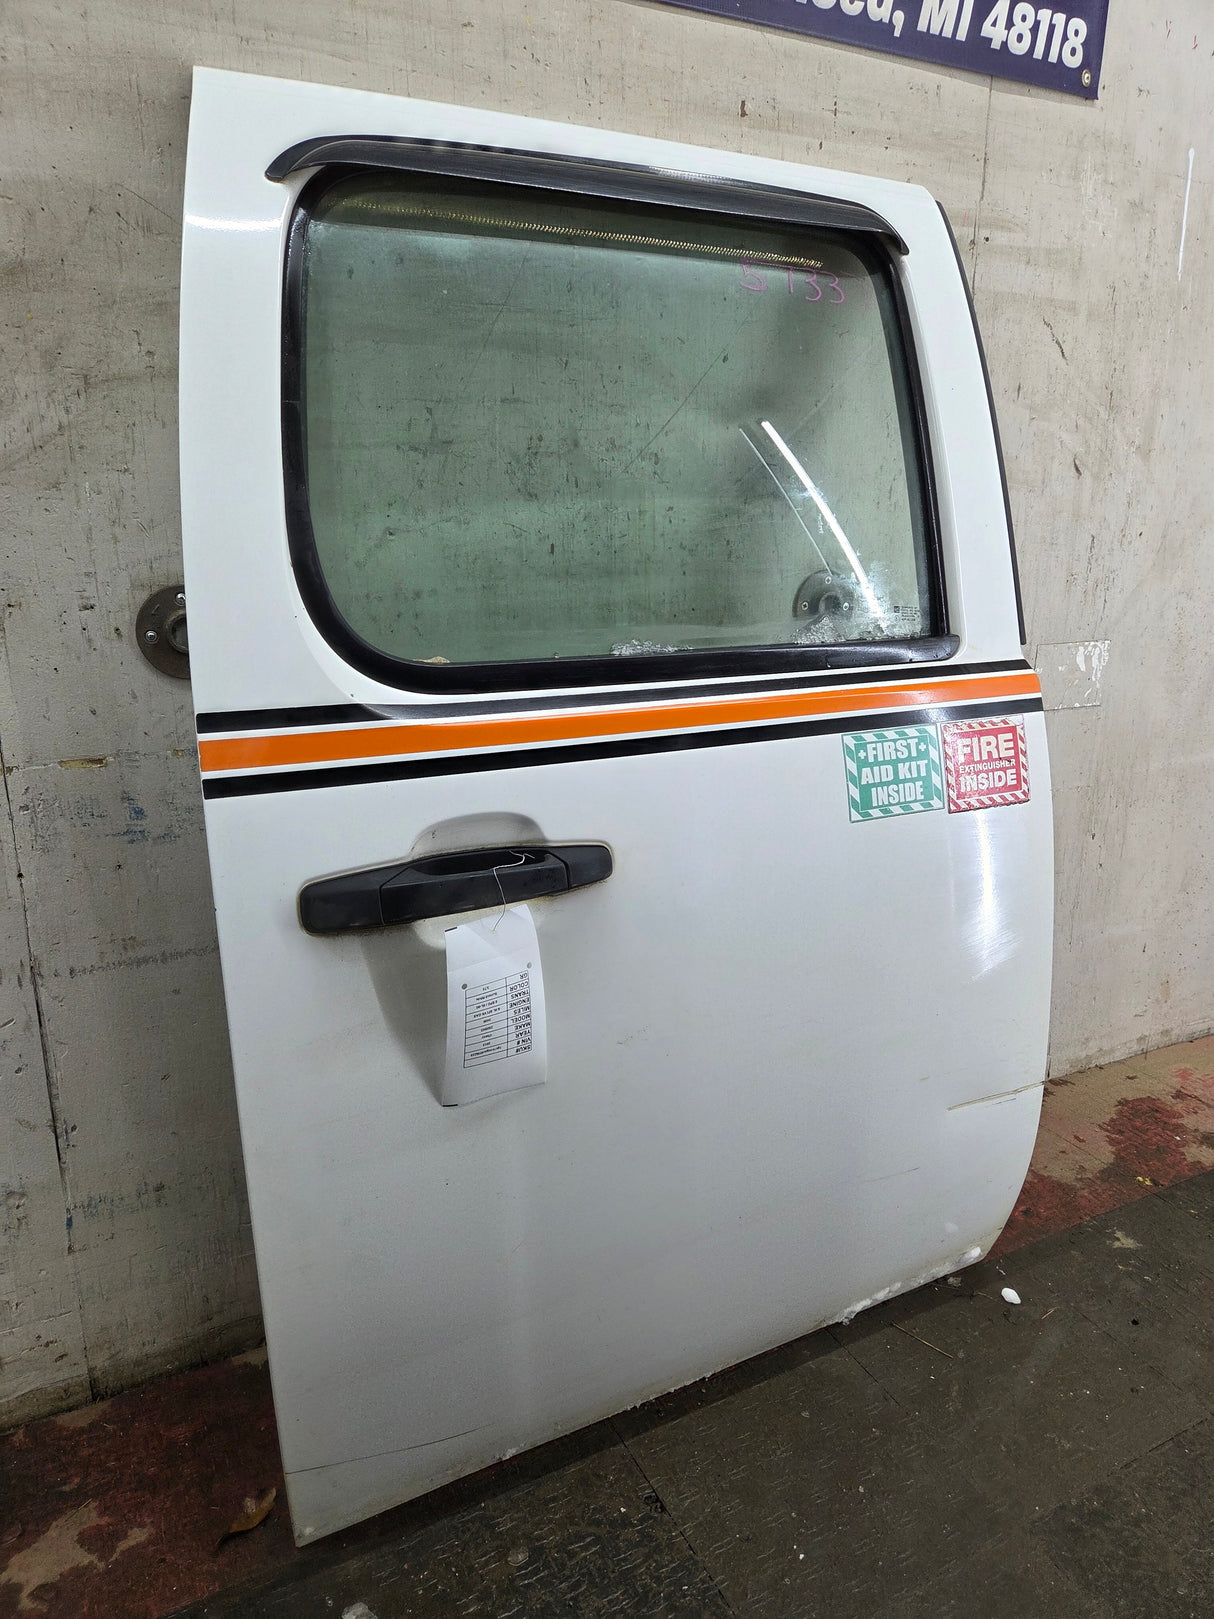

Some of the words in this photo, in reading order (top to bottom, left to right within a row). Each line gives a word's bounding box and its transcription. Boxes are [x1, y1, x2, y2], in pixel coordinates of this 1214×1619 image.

[917, 0, 973, 42] MI
[980, 1, 1088, 69] 48118
[865, 738, 919, 763] FIRST
[957, 732, 1015, 764] FIRE
[860, 764, 894, 786] AID
[897, 759, 929, 780] KIT
[959, 758, 1016, 774] EXTINGUISHER
[959, 768, 1018, 793] INSIDE
[870, 781, 925, 807] INSIDE
[509, 980, 529, 992] COLOR
[510, 989, 529, 1000] TRANS
[509, 997, 530, 1009] ENGINE
[513, 1005, 530, 1015] MILES
[511, 1013, 530, 1024] MODEL
[514, 1021, 531, 1030] MAKE
[515, 1029, 530, 1039] YEAR
